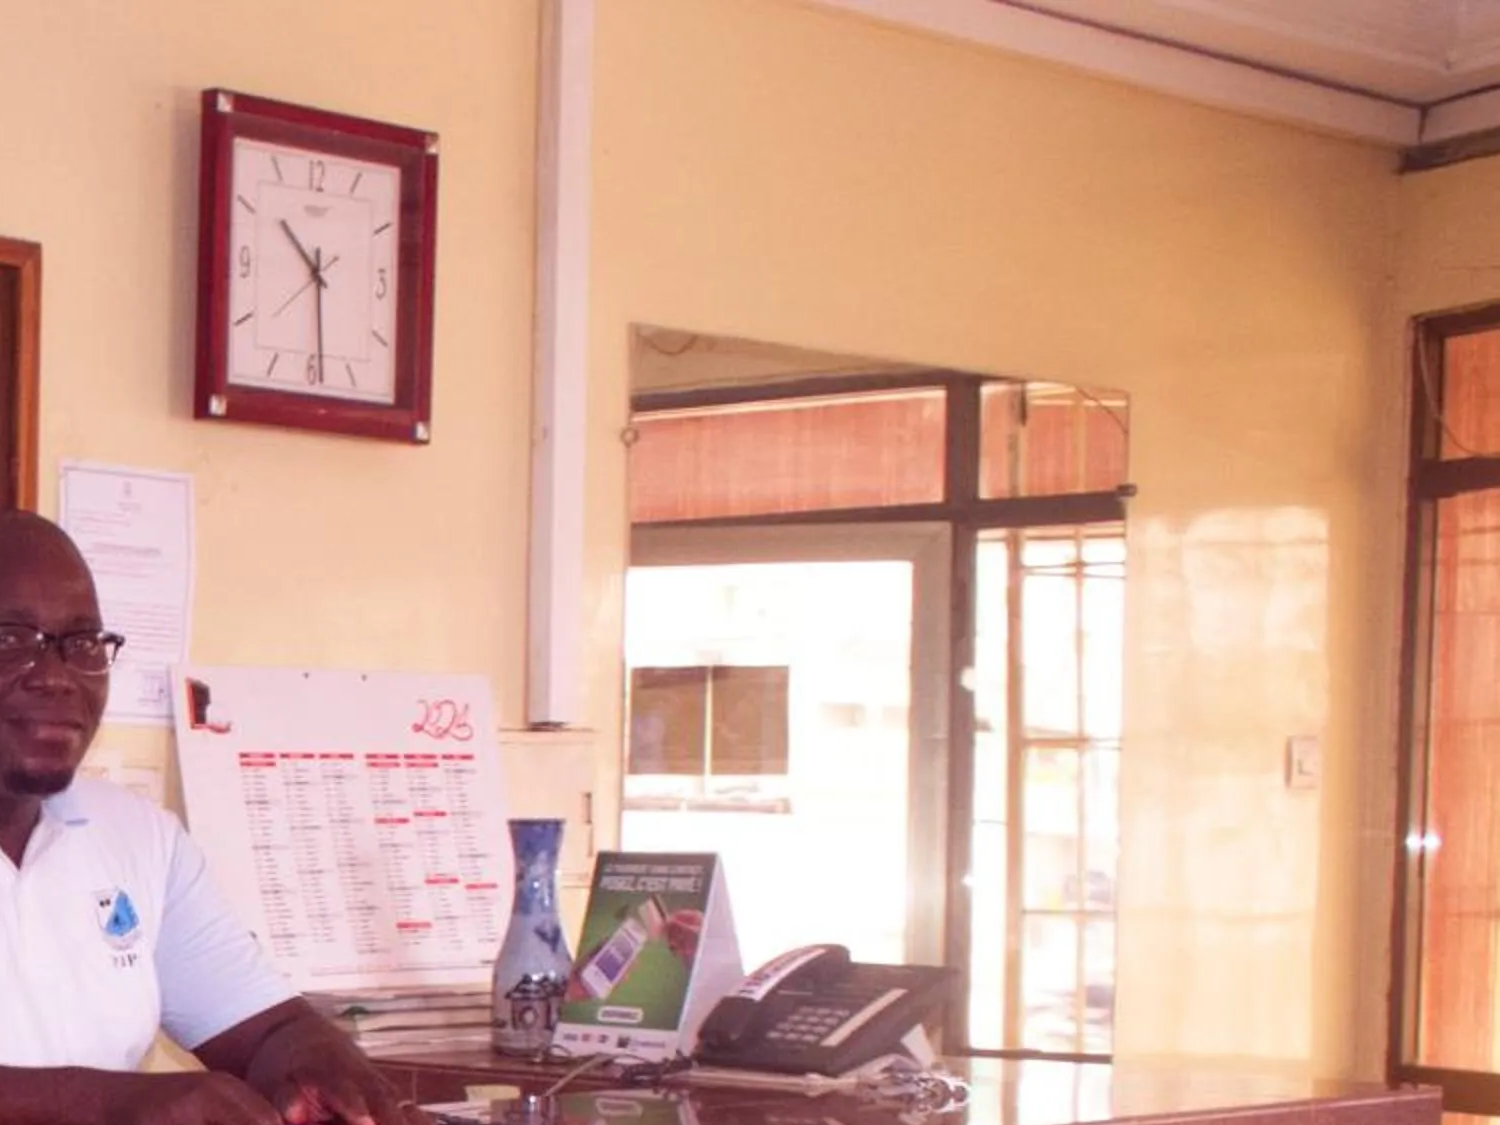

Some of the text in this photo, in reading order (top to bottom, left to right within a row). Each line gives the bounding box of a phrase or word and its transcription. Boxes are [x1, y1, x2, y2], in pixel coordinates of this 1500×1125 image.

[308, 160, 325, 192] 12
[240, 245, 251, 278] 9
[375, 268, 387, 299] 3
[306, 354, 317, 385] 6
